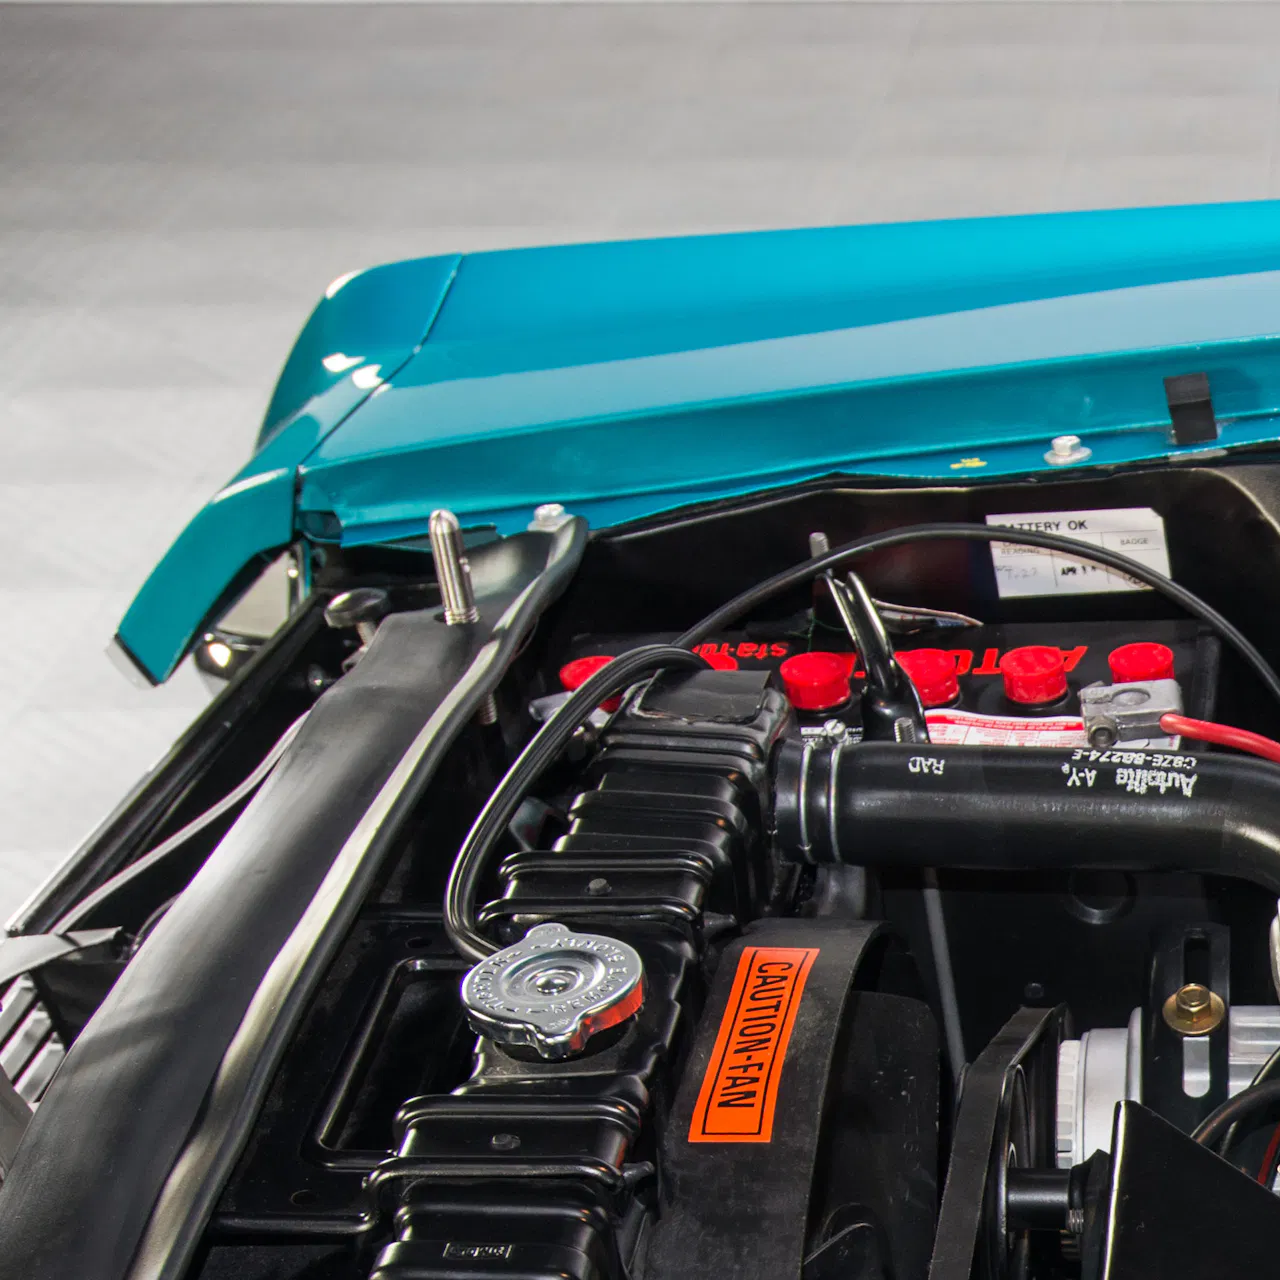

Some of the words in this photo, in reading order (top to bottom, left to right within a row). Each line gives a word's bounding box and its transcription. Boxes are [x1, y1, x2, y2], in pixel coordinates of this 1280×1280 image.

[1067, 519, 1088, 530] OK
[1119, 537, 1148, 545] BADGE
[907, 755, 945, 775] RAD
[1114, 766, 1198, 797] Autolite
[716, 959, 794, 1110] CAUTION-FAN
